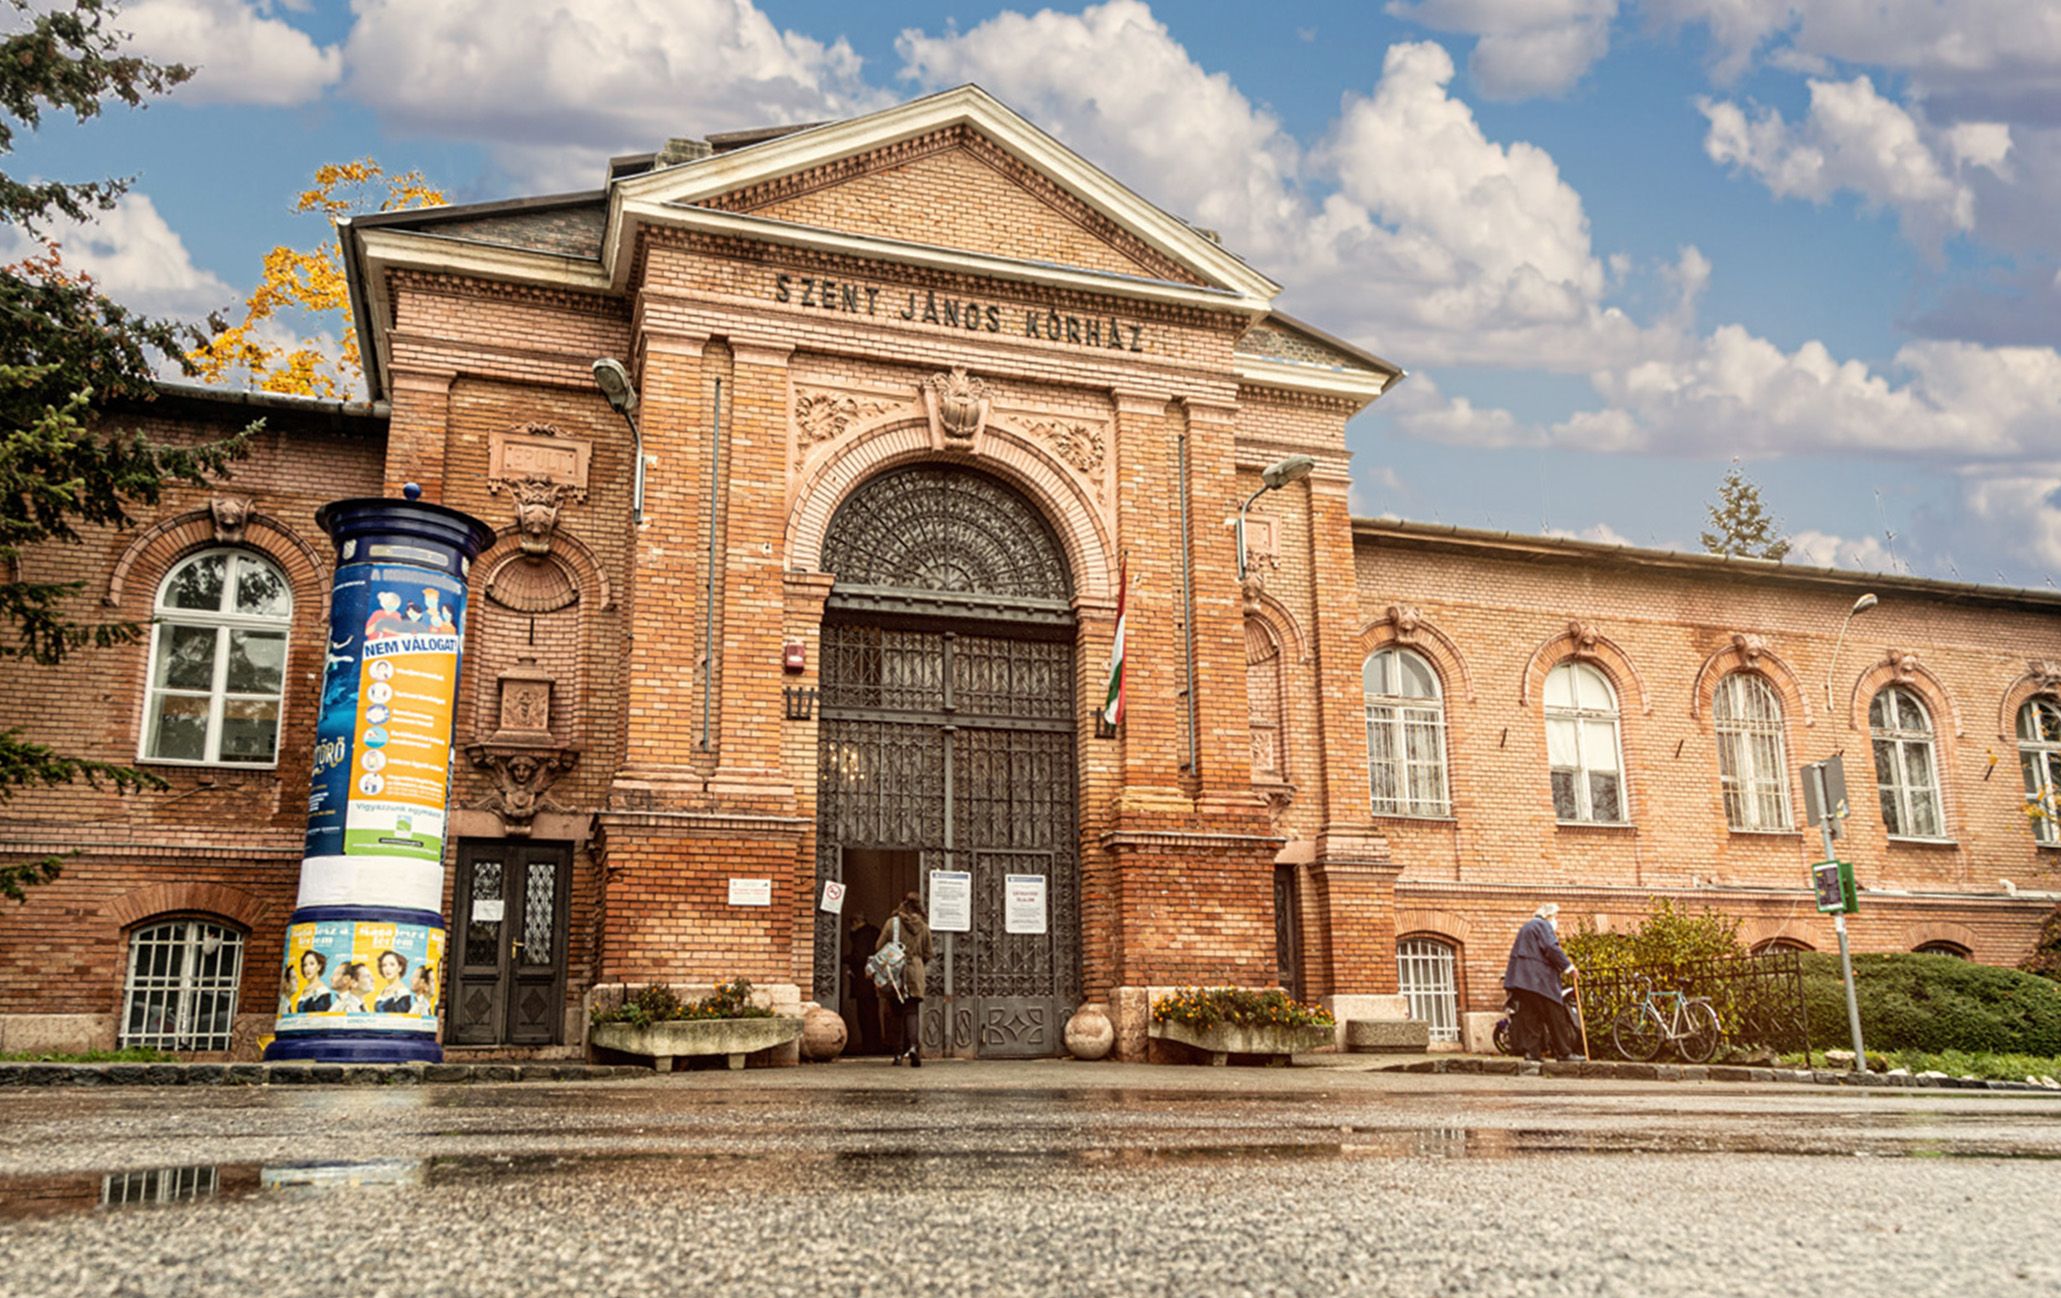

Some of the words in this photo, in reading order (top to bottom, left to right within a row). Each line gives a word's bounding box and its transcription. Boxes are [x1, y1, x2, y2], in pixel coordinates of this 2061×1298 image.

[776, 273, 880, 316] SZENT
[901, 289, 1001, 333] JÁNOS
[1026, 308, 1143, 353] KÓRHÁZ
[365, 640, 399, 657] NEM
[401, 636, 457, 652] VÁLOGAT!
